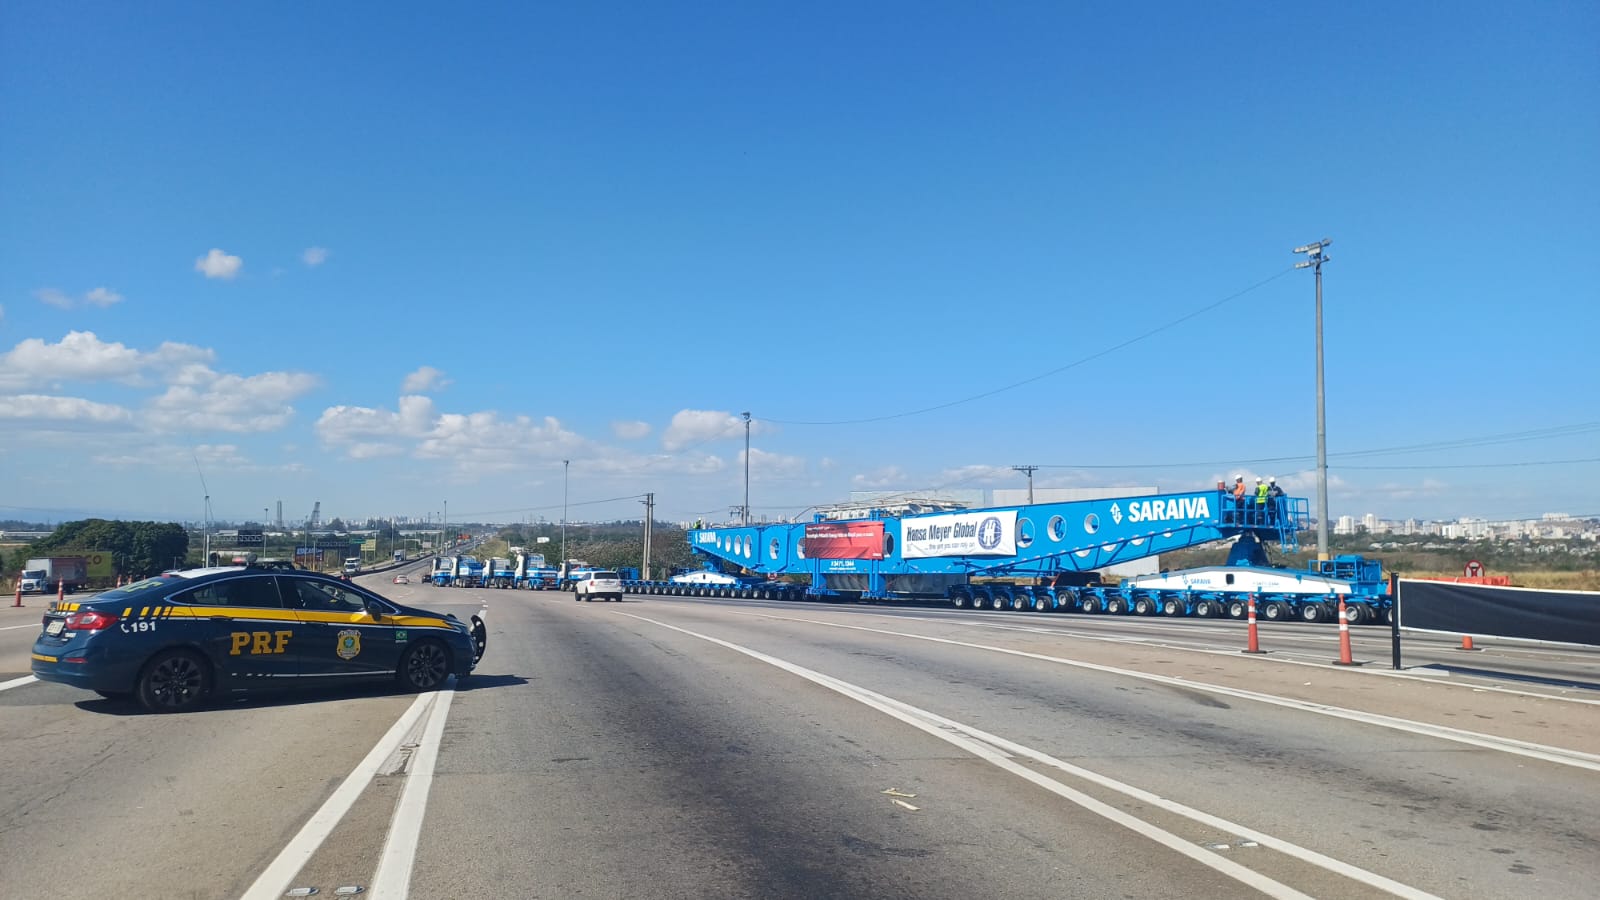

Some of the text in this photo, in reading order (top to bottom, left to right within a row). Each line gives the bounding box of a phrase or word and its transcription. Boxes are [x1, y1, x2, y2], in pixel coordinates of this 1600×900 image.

[1128, 497, 1210, 523] SARAIVA
[906, 521, 978, 542] Hansa Meyer Global
[130, 621, 156, 633] 191
[229, 630, 293, 656] PRF
